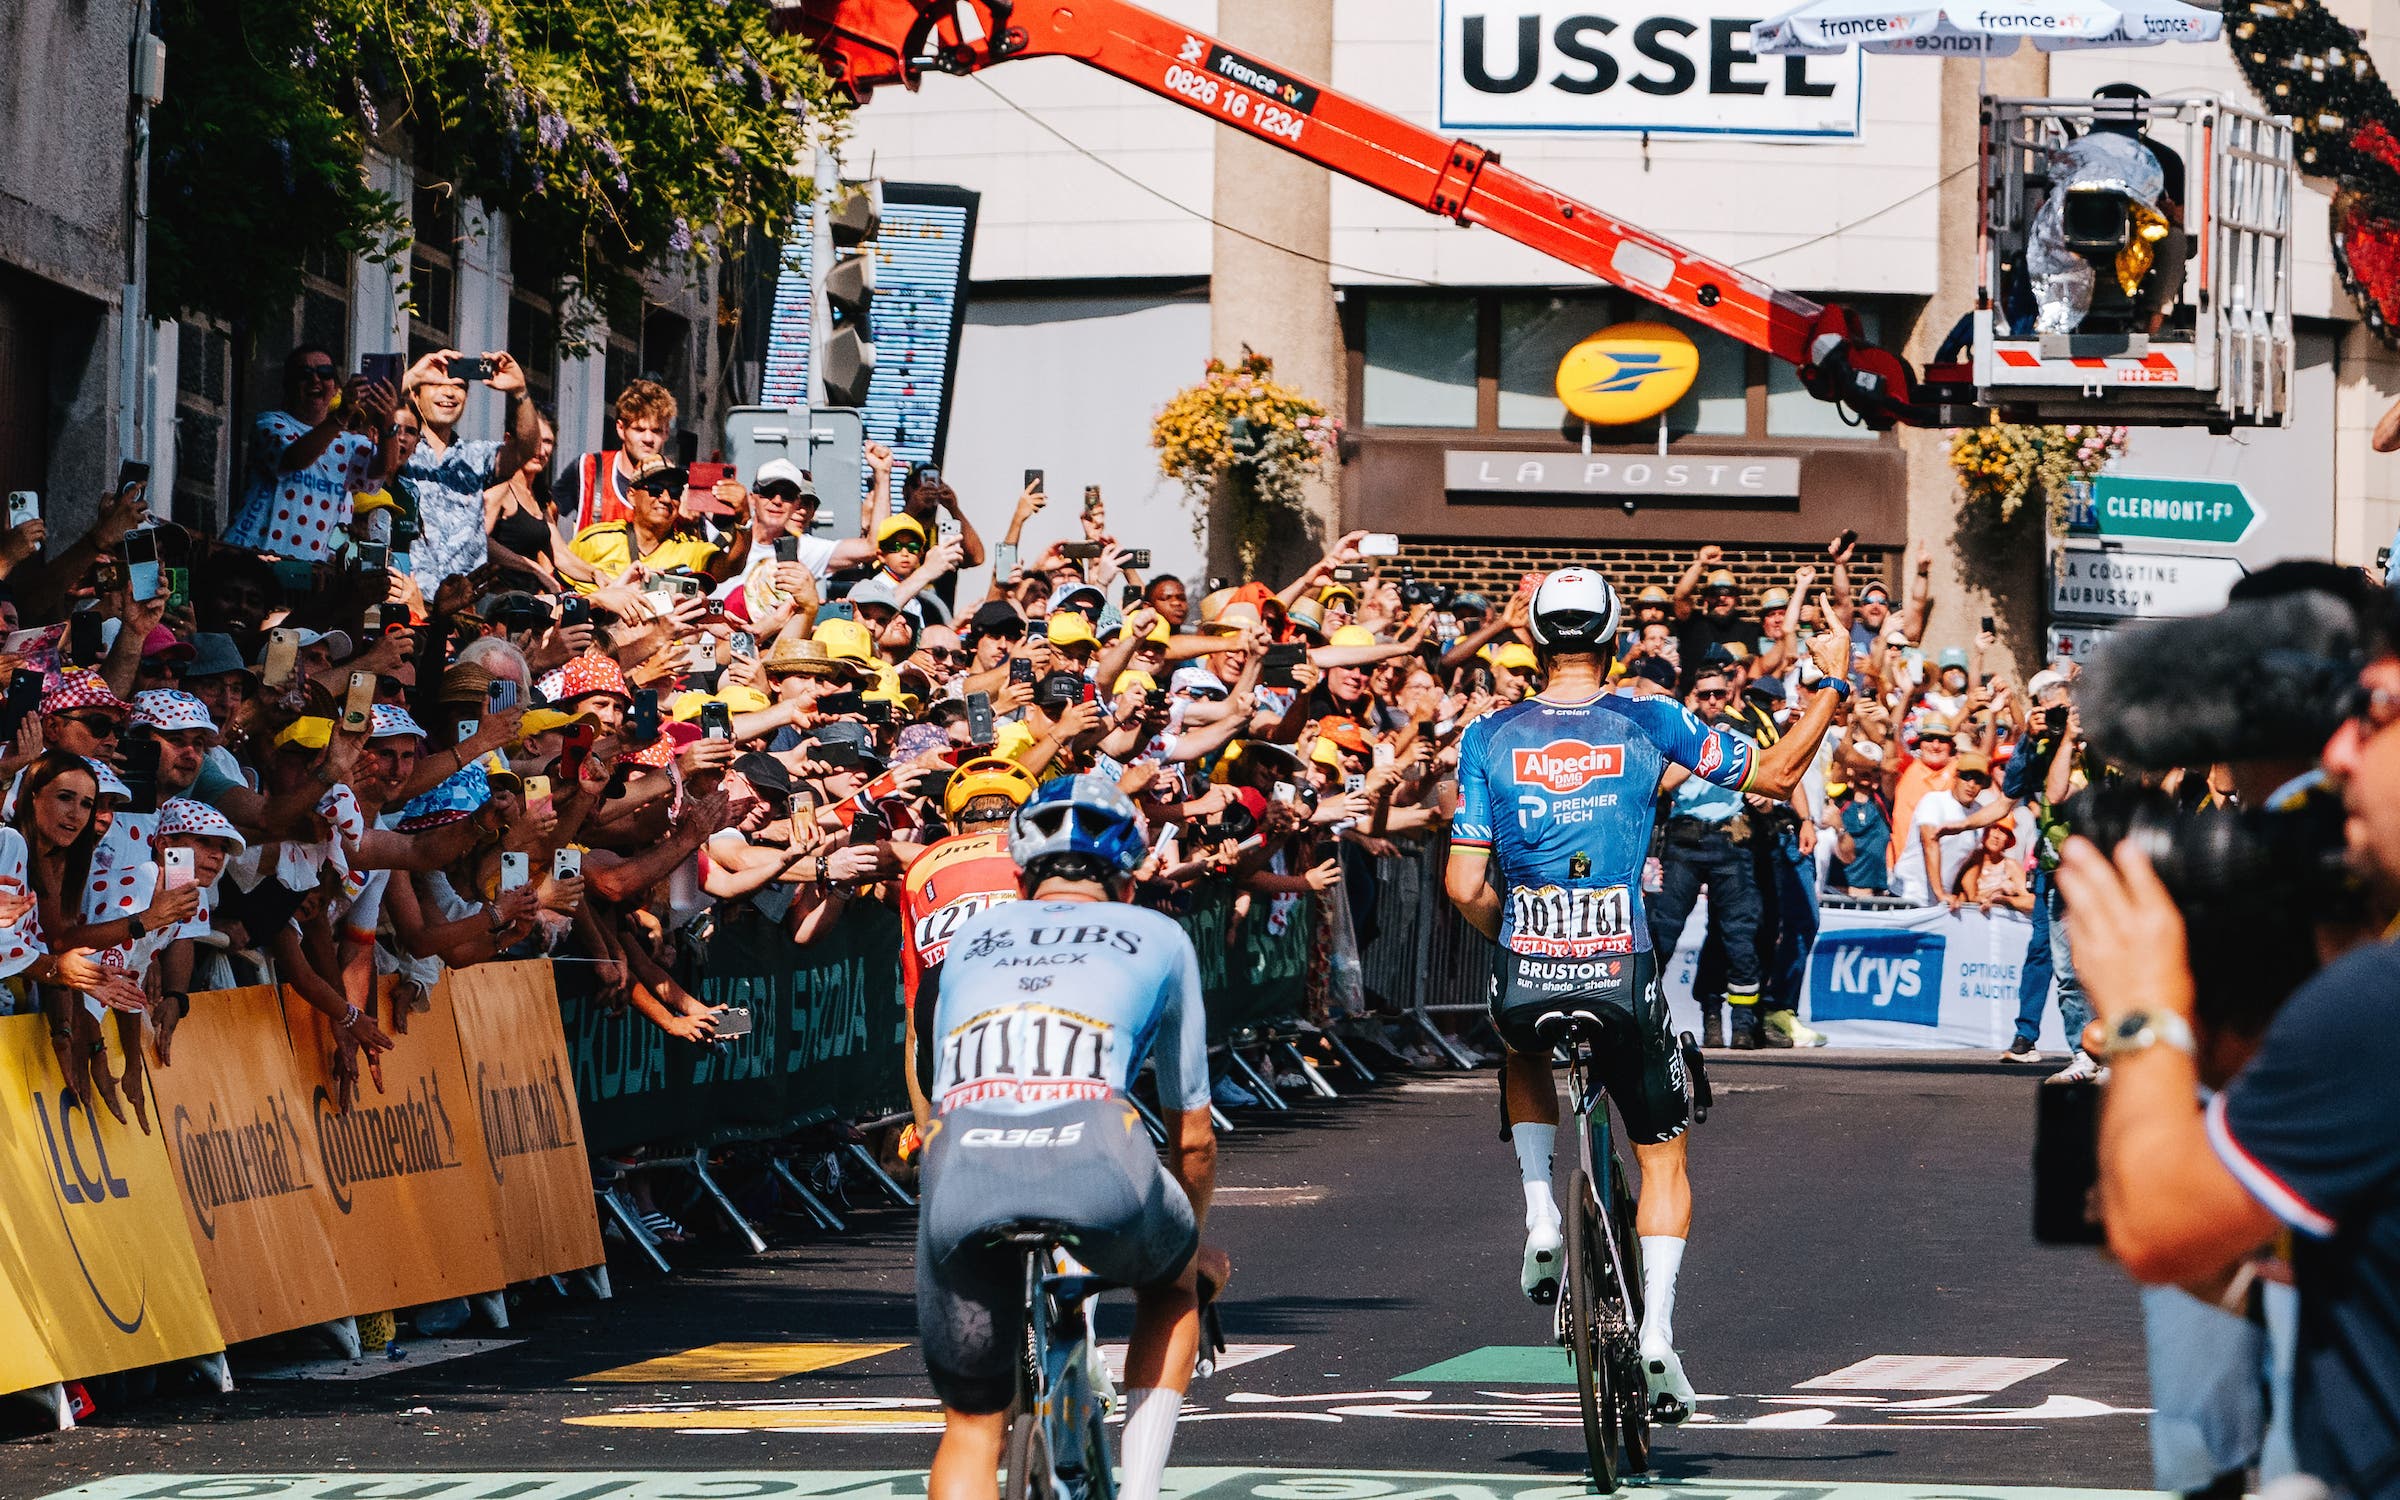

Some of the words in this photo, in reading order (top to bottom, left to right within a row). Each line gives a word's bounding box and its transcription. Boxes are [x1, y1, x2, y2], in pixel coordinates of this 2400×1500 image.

[1462, 13, 1837, 97] USSEL
[1164, 65, 1219, 105] 0826
[1222, 89, 1250, 118] 16
[1252, 102, 1305, 142] 1234
[1478, 460, 1545, 483] LA
[1584, 461, 1767, 488] POSTE
[2058, 586, 2154, 606] AUBUSSON
[1523, 749, 1612, 782] Alpecin
[1552, 794, 1618, 812] PREMIER
[1553, 809, 1593, 825] TECH
[1517, 895, 1567, 938] 101
[1029, 925, 1143, 955] UBS
[993, 952, 1089, 969] AMACX
[1518, 959, 1609, 980] BRUSTOR
[1830, 944, 1922, 1006] Krys
[1961, 962, 2016, 980] OPTIQUE
[1517, 977, 1534, 989] sun
[1541, 979, 1574, 992] shade
[1584, 978, 1623, 990] shelter
[951, 1015, 1015, 1087] 171
[1032, 1015, 1106, 1081] 171
[1668, 1049, 1682, 1092] TECH
[34, 1086, 130, 1204] LCL
[313, 1076, 444, 1215] Continental
[960, 1121, 1086, 1148] Q36.5
[174, 1095, 296, 1241] Continental
